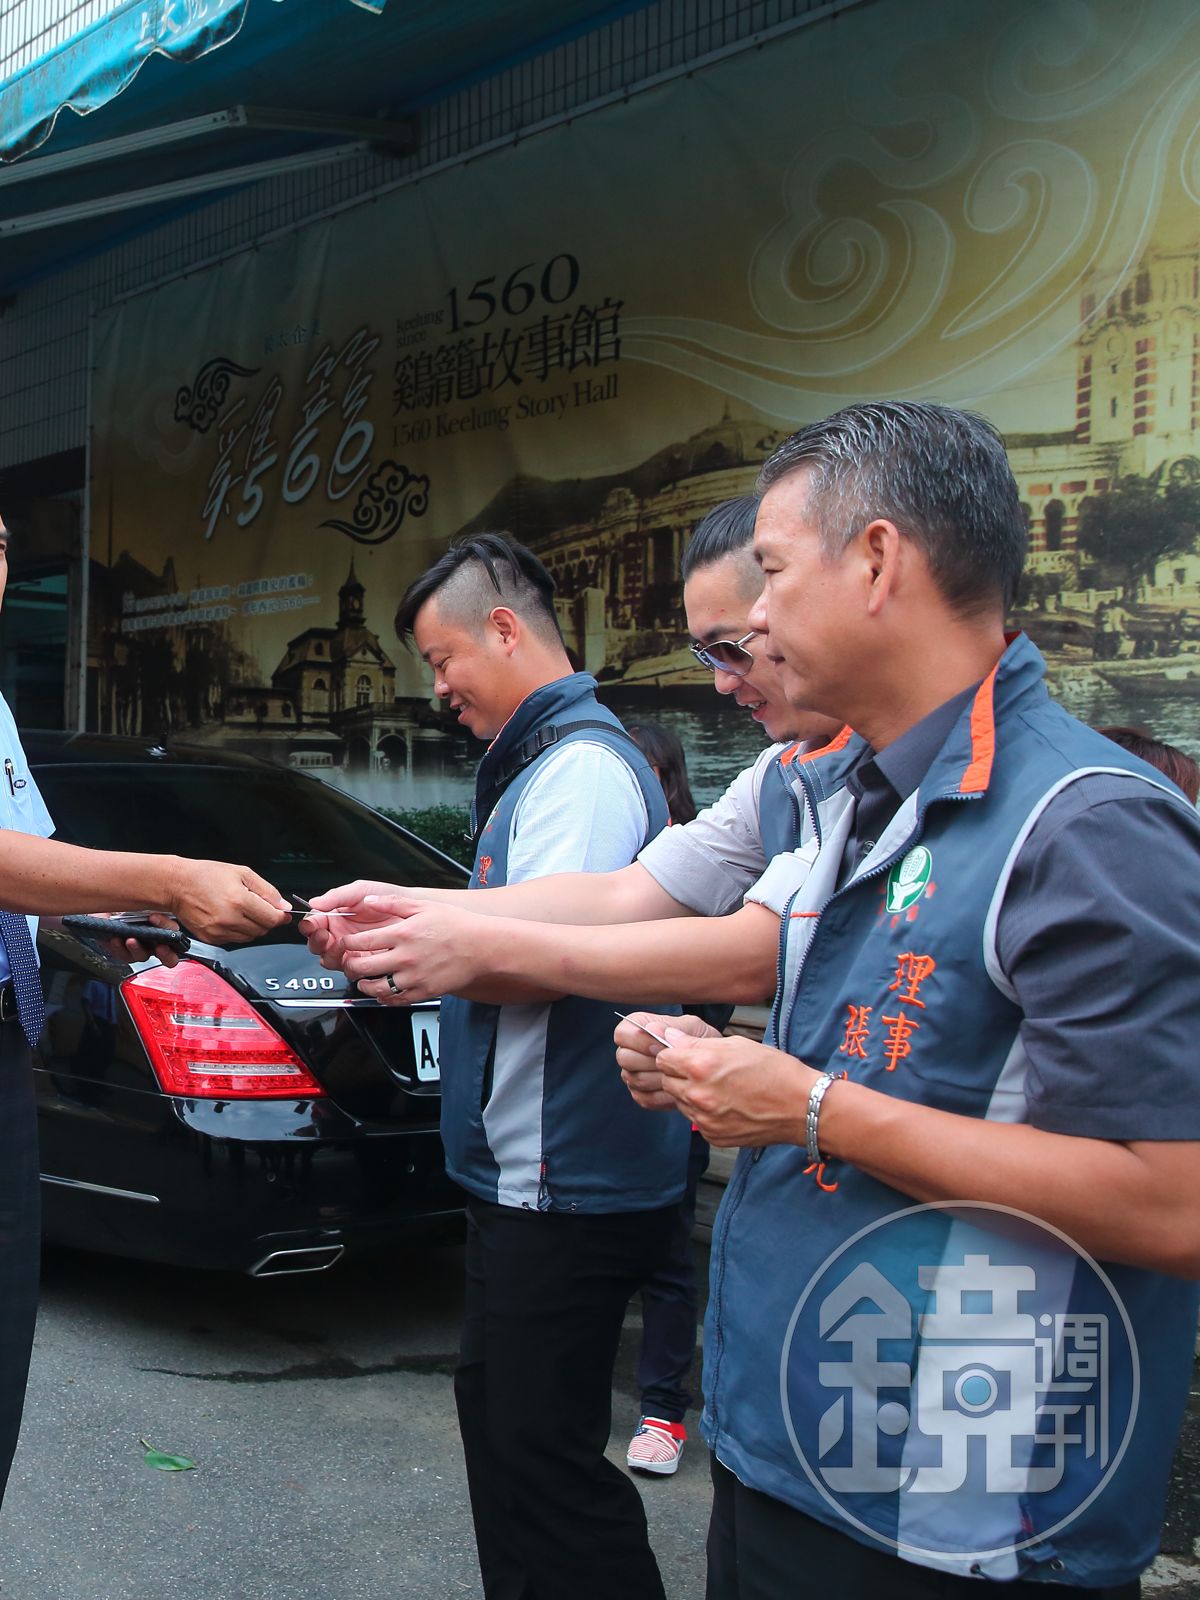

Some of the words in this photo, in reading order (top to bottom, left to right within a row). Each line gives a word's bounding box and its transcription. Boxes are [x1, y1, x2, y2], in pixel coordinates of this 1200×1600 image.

[446, 254, 579, 335] 1560
[392, 418, 432, 448] 1560
[436, 406, 512, 438] Keelung
[516, 392, 571, 420] Story
[573, 373, 618, 407] Hall
[265, 978, 280, 991] S
[284, 977, 334, 990] 400
[882, 951, 936, 1072] 理事
[420, 1028, 441, 1070] A
